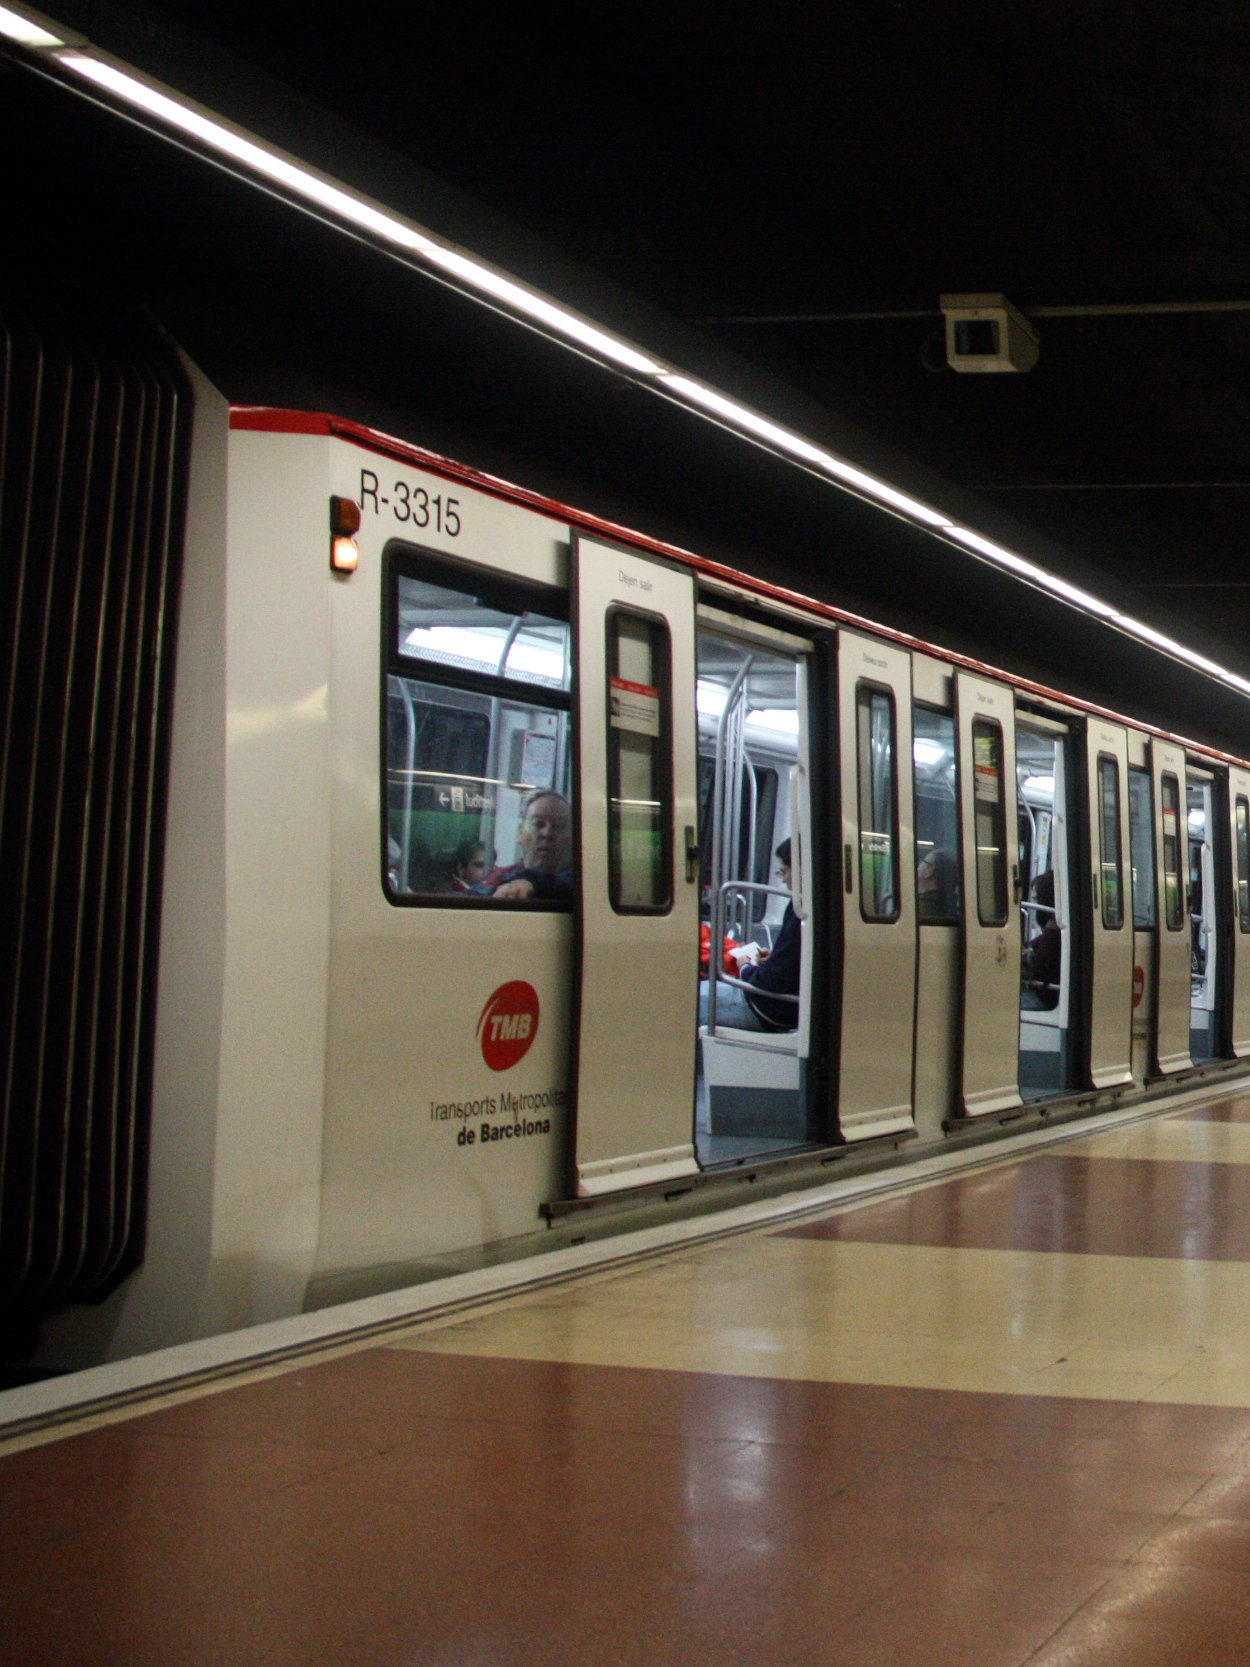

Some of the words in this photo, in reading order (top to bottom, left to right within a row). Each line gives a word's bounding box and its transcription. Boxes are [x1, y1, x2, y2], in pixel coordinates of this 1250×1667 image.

[361, 469, 460, 537] R-3315
[490, 1013, 533, 1041] TMB
[430, 1096, 496, 1123] Transports
[457, 1126, 476, 1146] de
[480, 1118, 551, 1143] Barcelona
